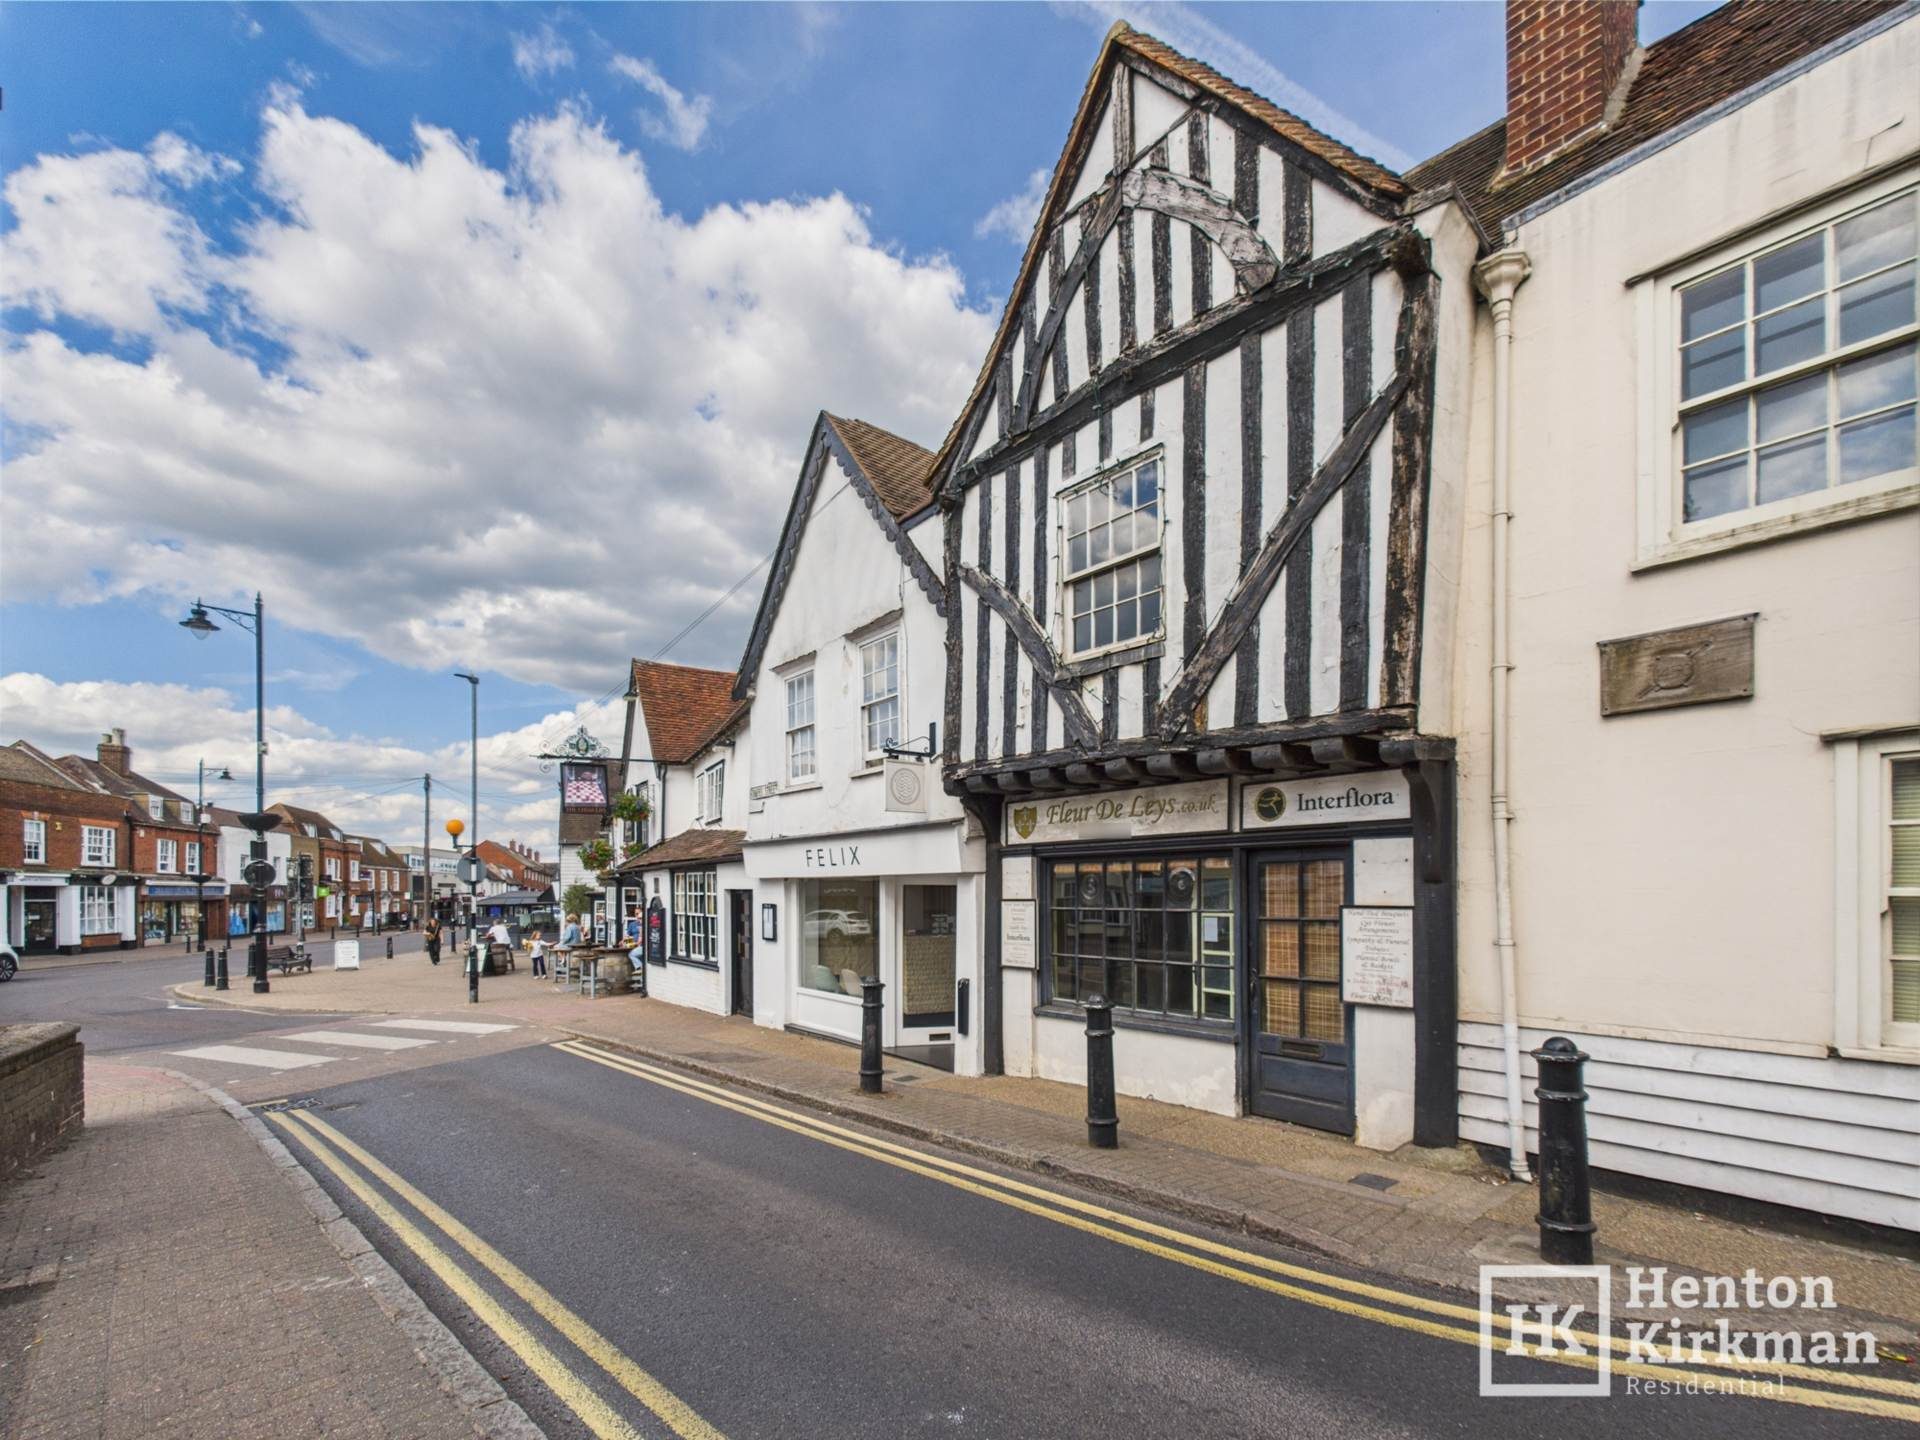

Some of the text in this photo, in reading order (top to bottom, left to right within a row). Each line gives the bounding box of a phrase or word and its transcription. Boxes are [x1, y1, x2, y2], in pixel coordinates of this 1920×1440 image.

[1046, 800, 1094, 825] Fleur
[1096, 798, 1123, 820] De
[1297, 787, 1395, 812] Interflora
[805, 845, 861, 868] FELIX
